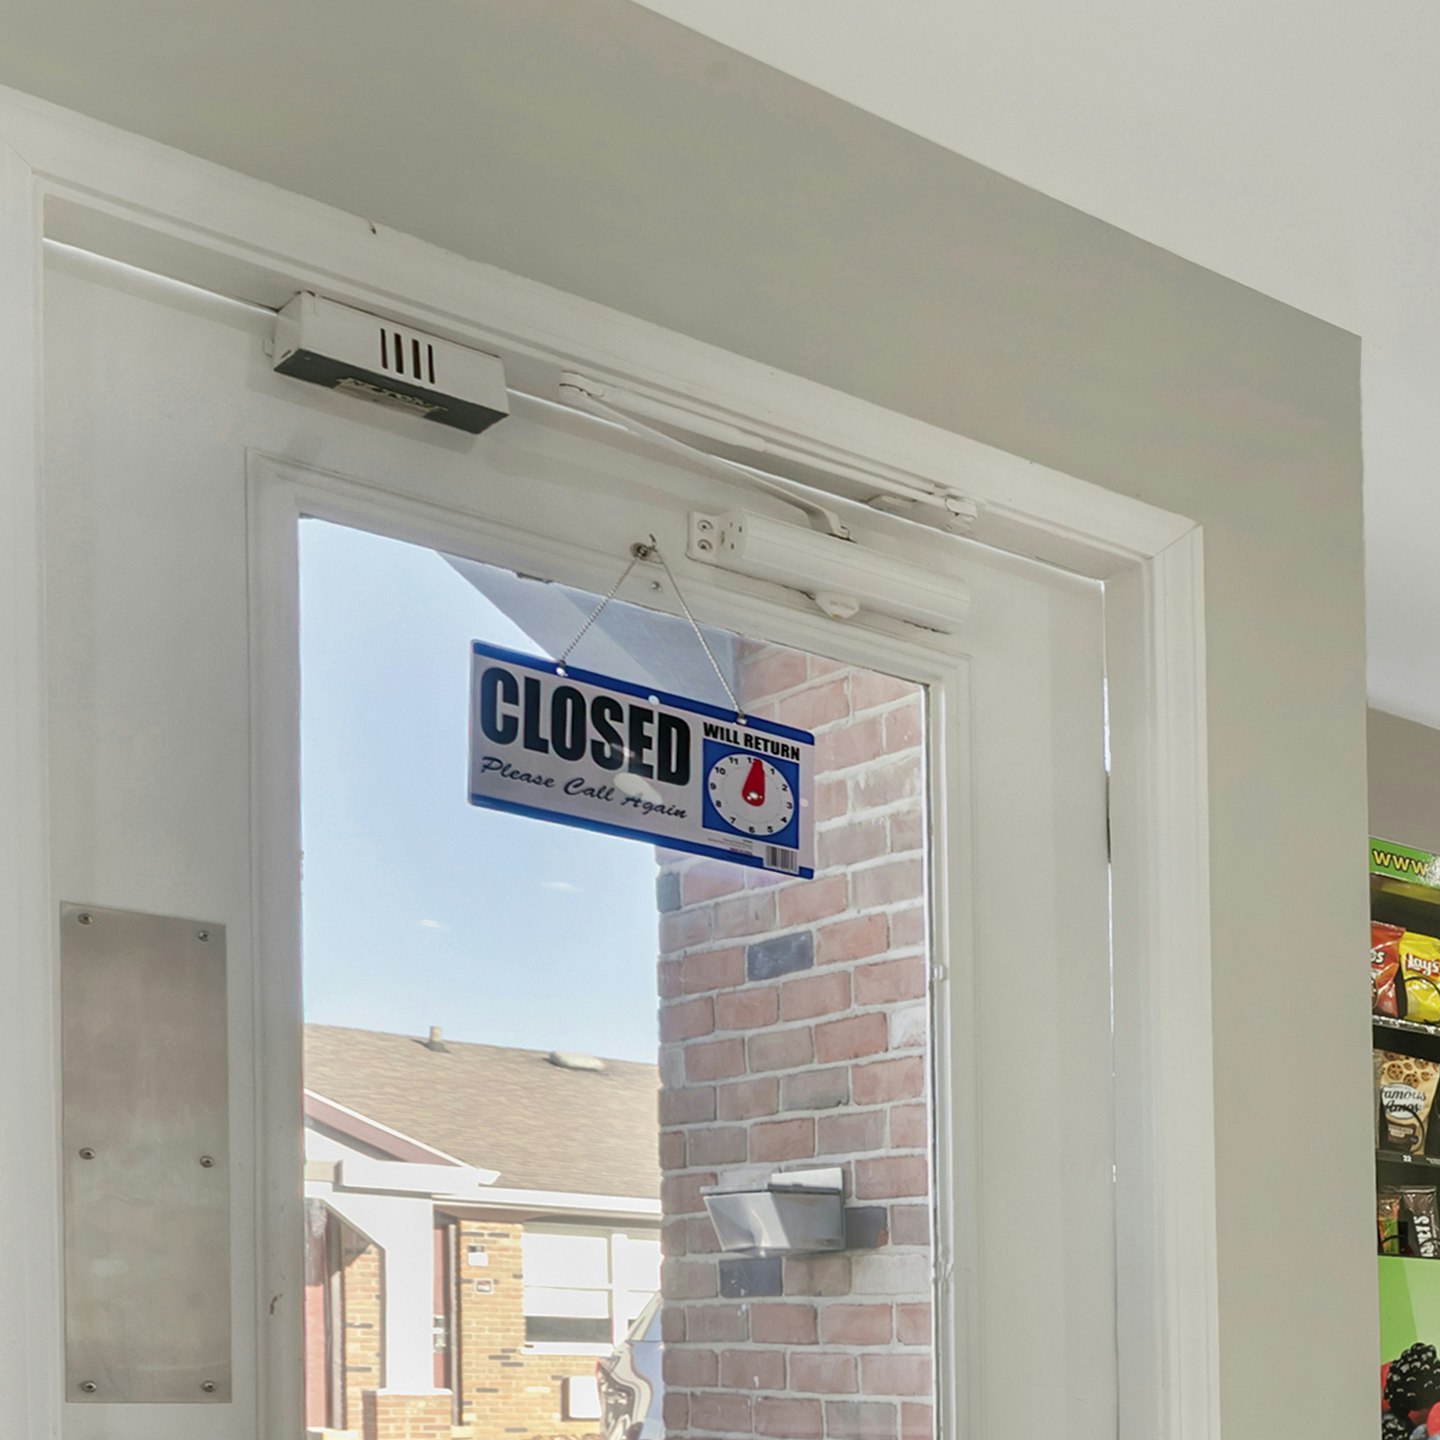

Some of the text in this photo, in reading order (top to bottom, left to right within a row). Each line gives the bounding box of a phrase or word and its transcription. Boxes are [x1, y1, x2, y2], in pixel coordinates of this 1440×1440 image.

[481, 667, 690, 786] CLOSED
[703, 722, 800, 760] WILL RETURN
[715, 767, 726, 775] 10
[729, 757, 739, 765] 11
[481, 756, 687, 818] Please Call Again
[782, 784, 788, 792] 2
[1407, 953, 1439, 976] Lay's
